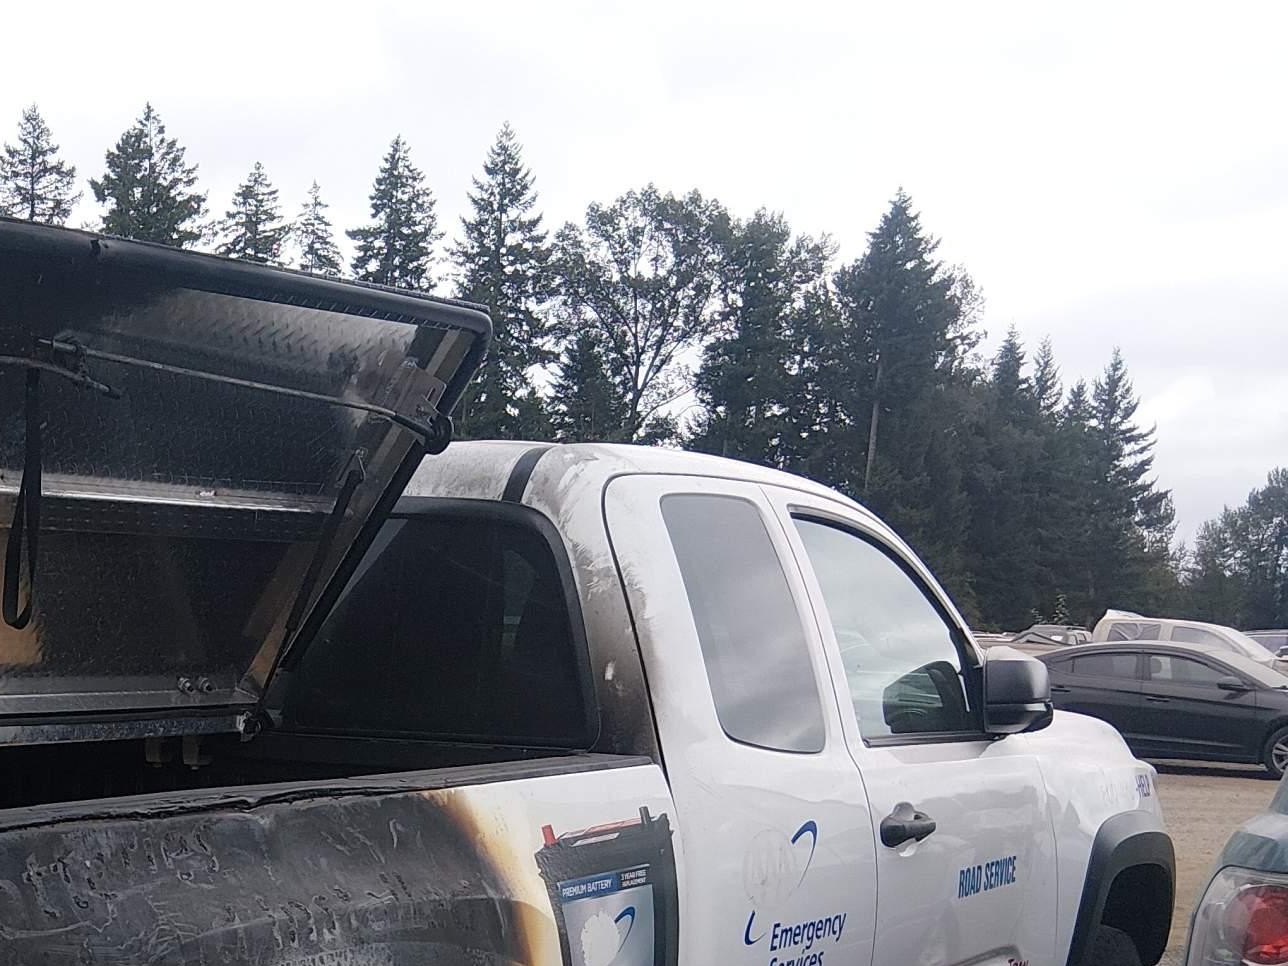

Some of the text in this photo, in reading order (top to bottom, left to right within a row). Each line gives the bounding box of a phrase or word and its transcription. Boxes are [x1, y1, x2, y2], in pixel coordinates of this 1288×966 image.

[562, 879, 613, 897] PREMIUM BATTERY
[958, 856, 1017, 899] ROAD SERVICE
[770, 912, 847, 952] Emergency
